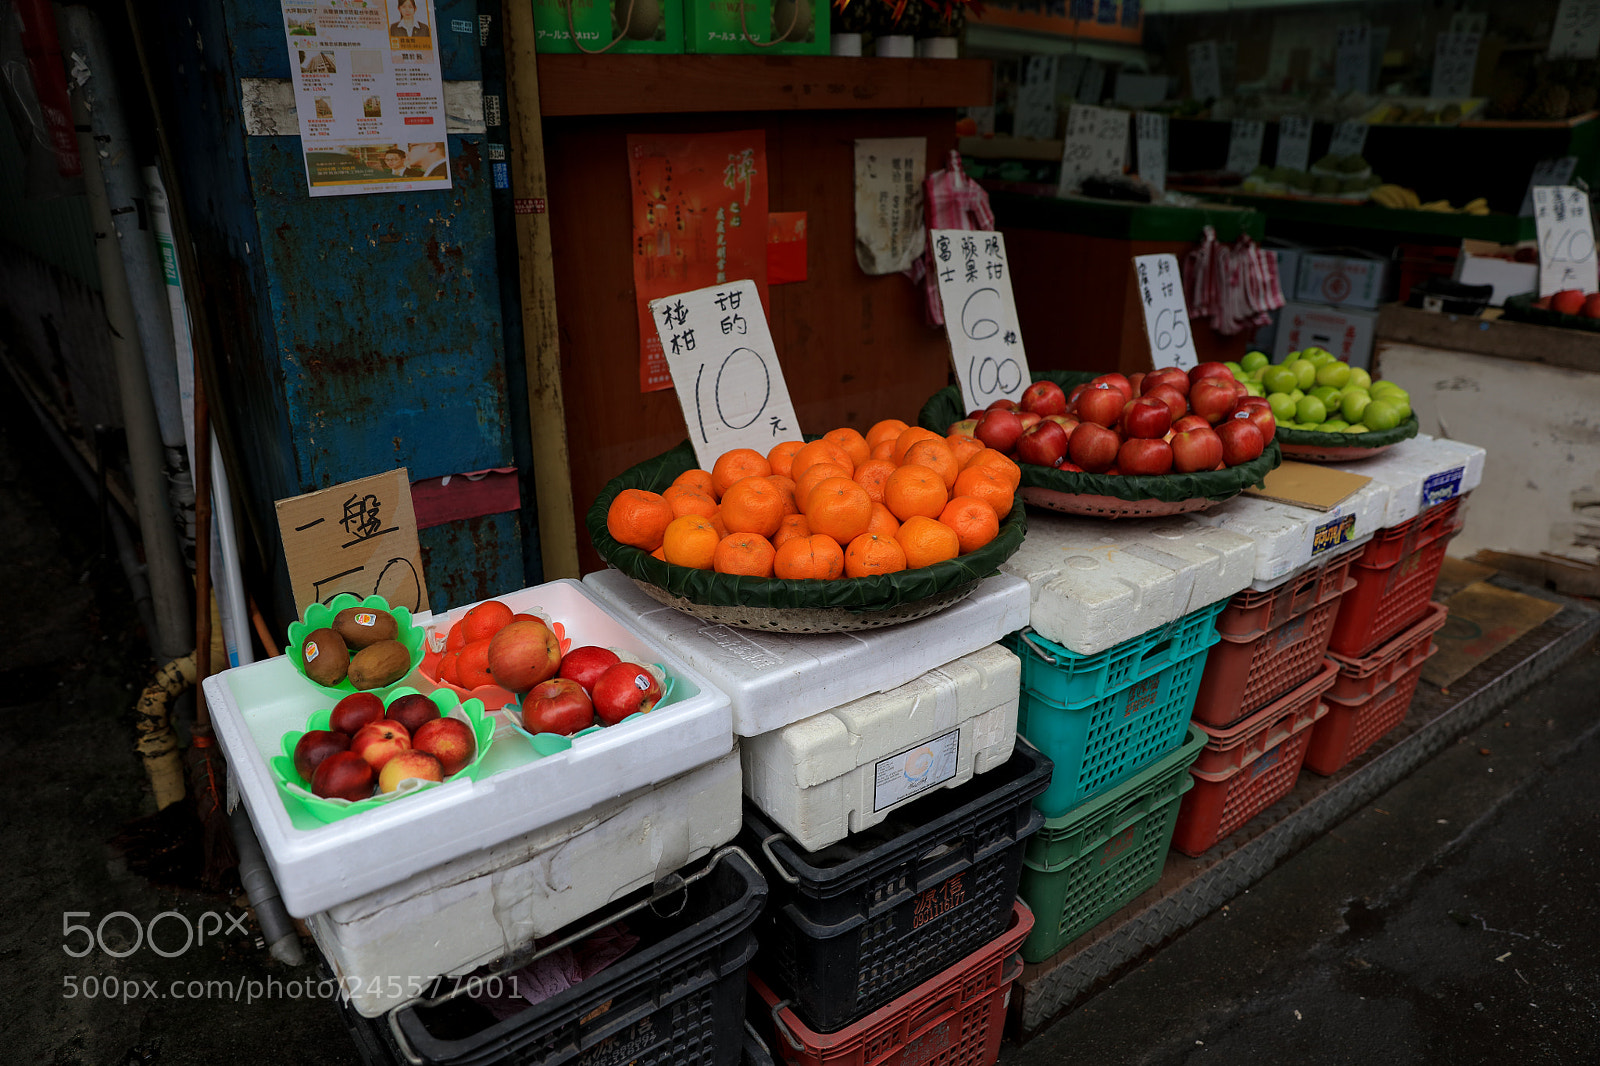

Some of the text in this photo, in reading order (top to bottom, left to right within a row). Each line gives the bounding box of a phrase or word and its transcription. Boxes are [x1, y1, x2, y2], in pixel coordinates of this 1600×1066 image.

[536, 30, 571, 40] アールス
[708, 32, 736, 41] アールス
[714, 290, 748, 335] 甜的
[1154, 308, 1188, 351] 65
[695, 347, 770, 444] 10
[969, 356, 1022, 407] 100
[913, 872, 966, 915] 源信
[913, 890, 966, 929] 0931116177
